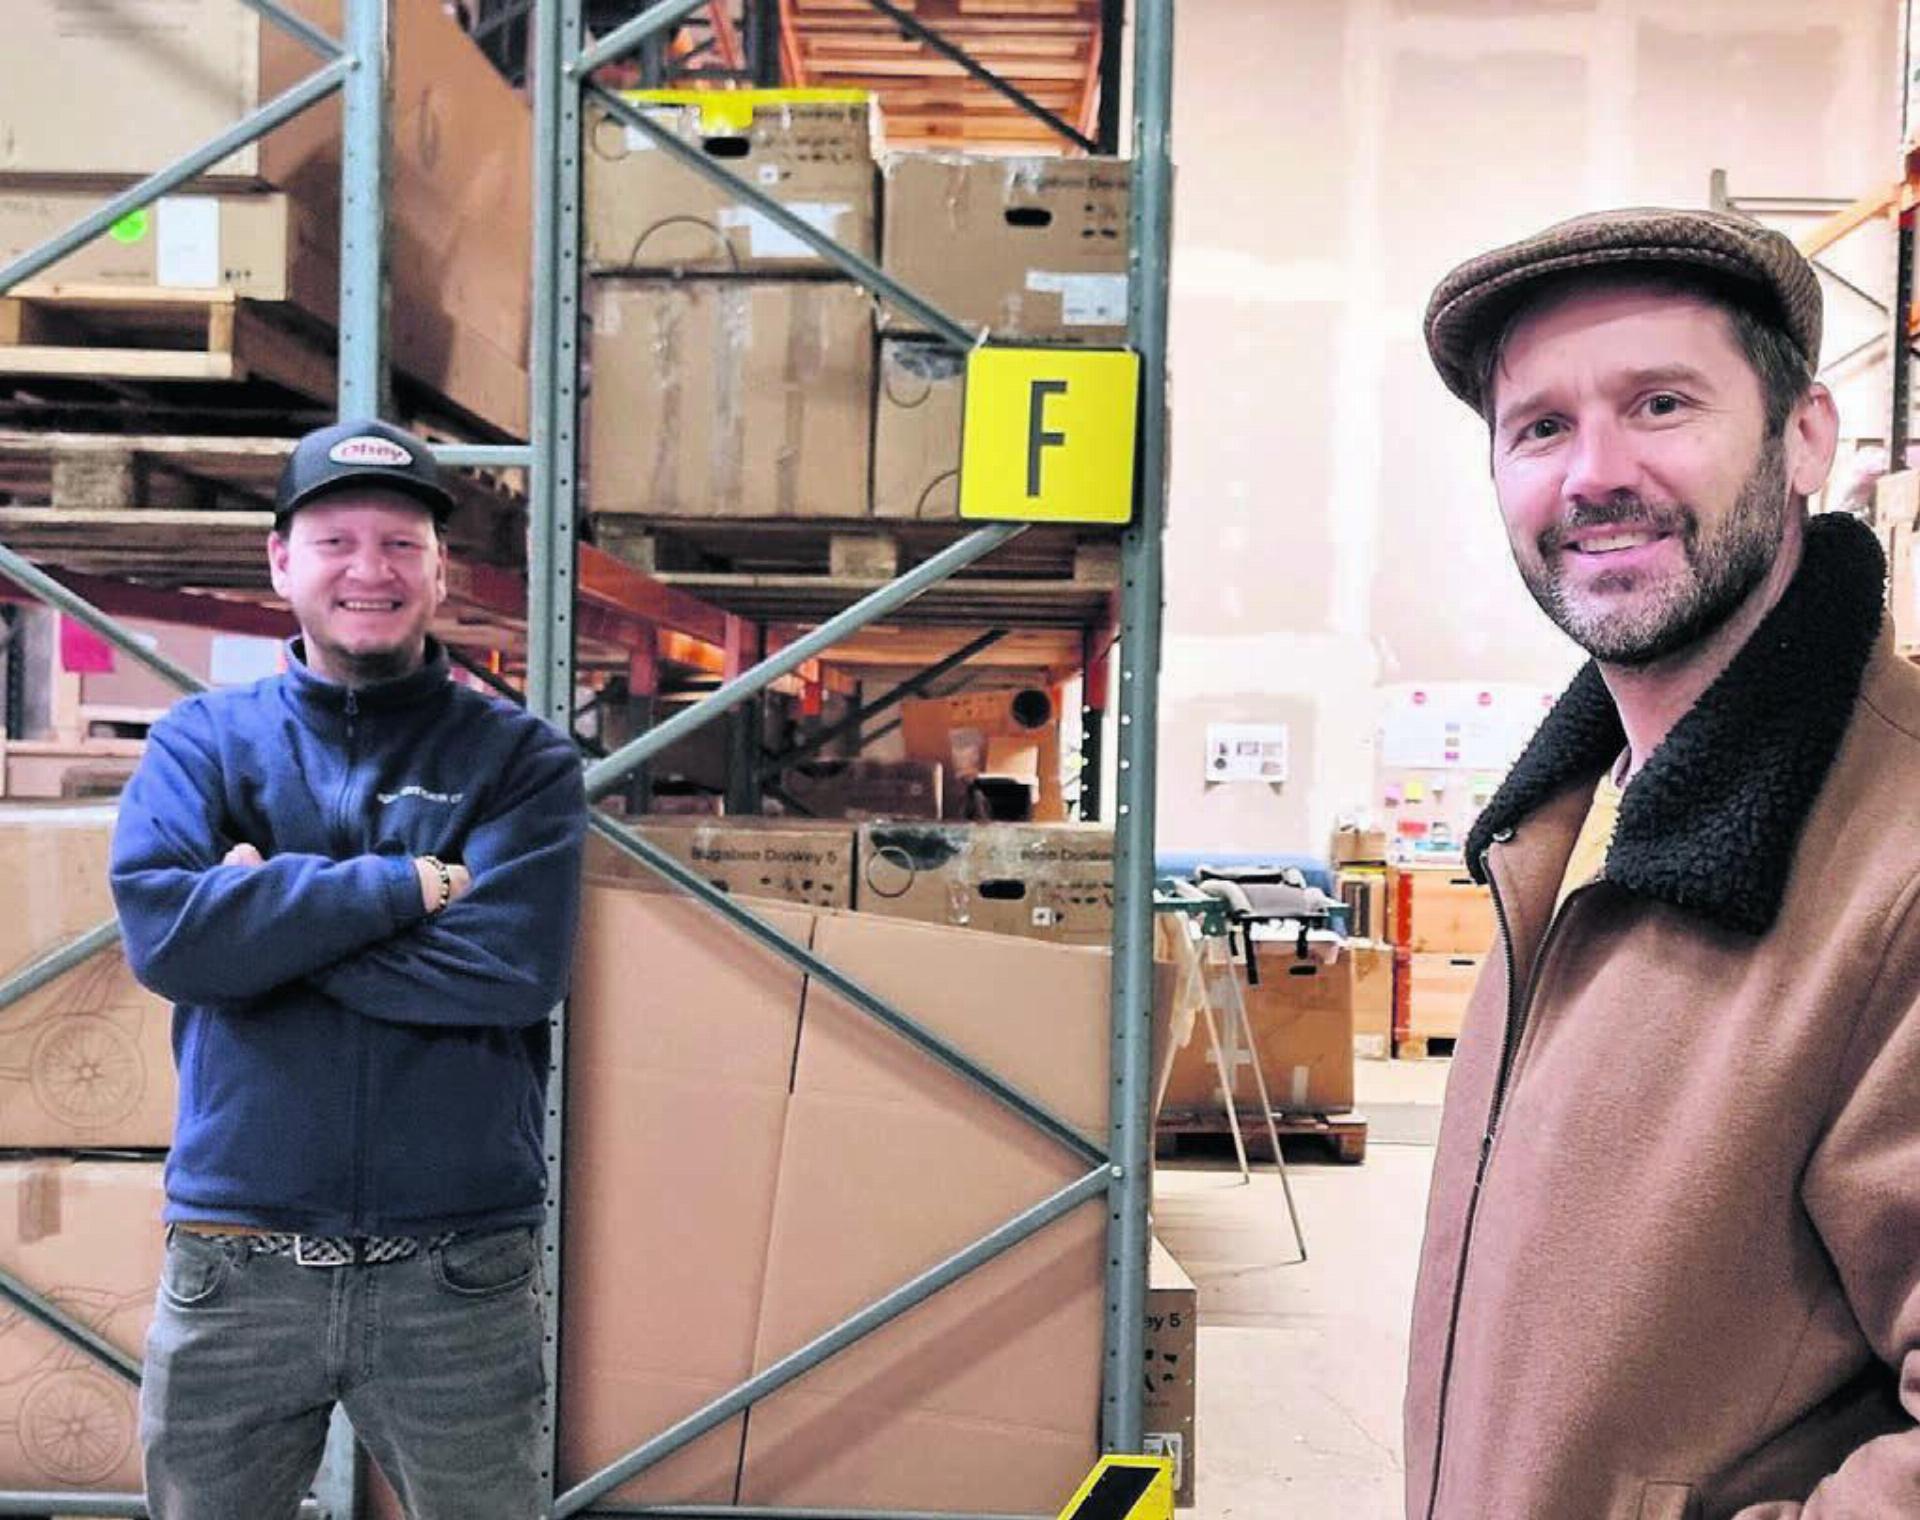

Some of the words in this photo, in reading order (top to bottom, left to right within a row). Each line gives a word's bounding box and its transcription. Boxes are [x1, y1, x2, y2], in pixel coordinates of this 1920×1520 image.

[1027, 380, 1067, 497] F
[764, 849, 824, 866] Donkey
[826, 850, 838, 865] 5
[1170, 1312, 1181, 1328] 5
